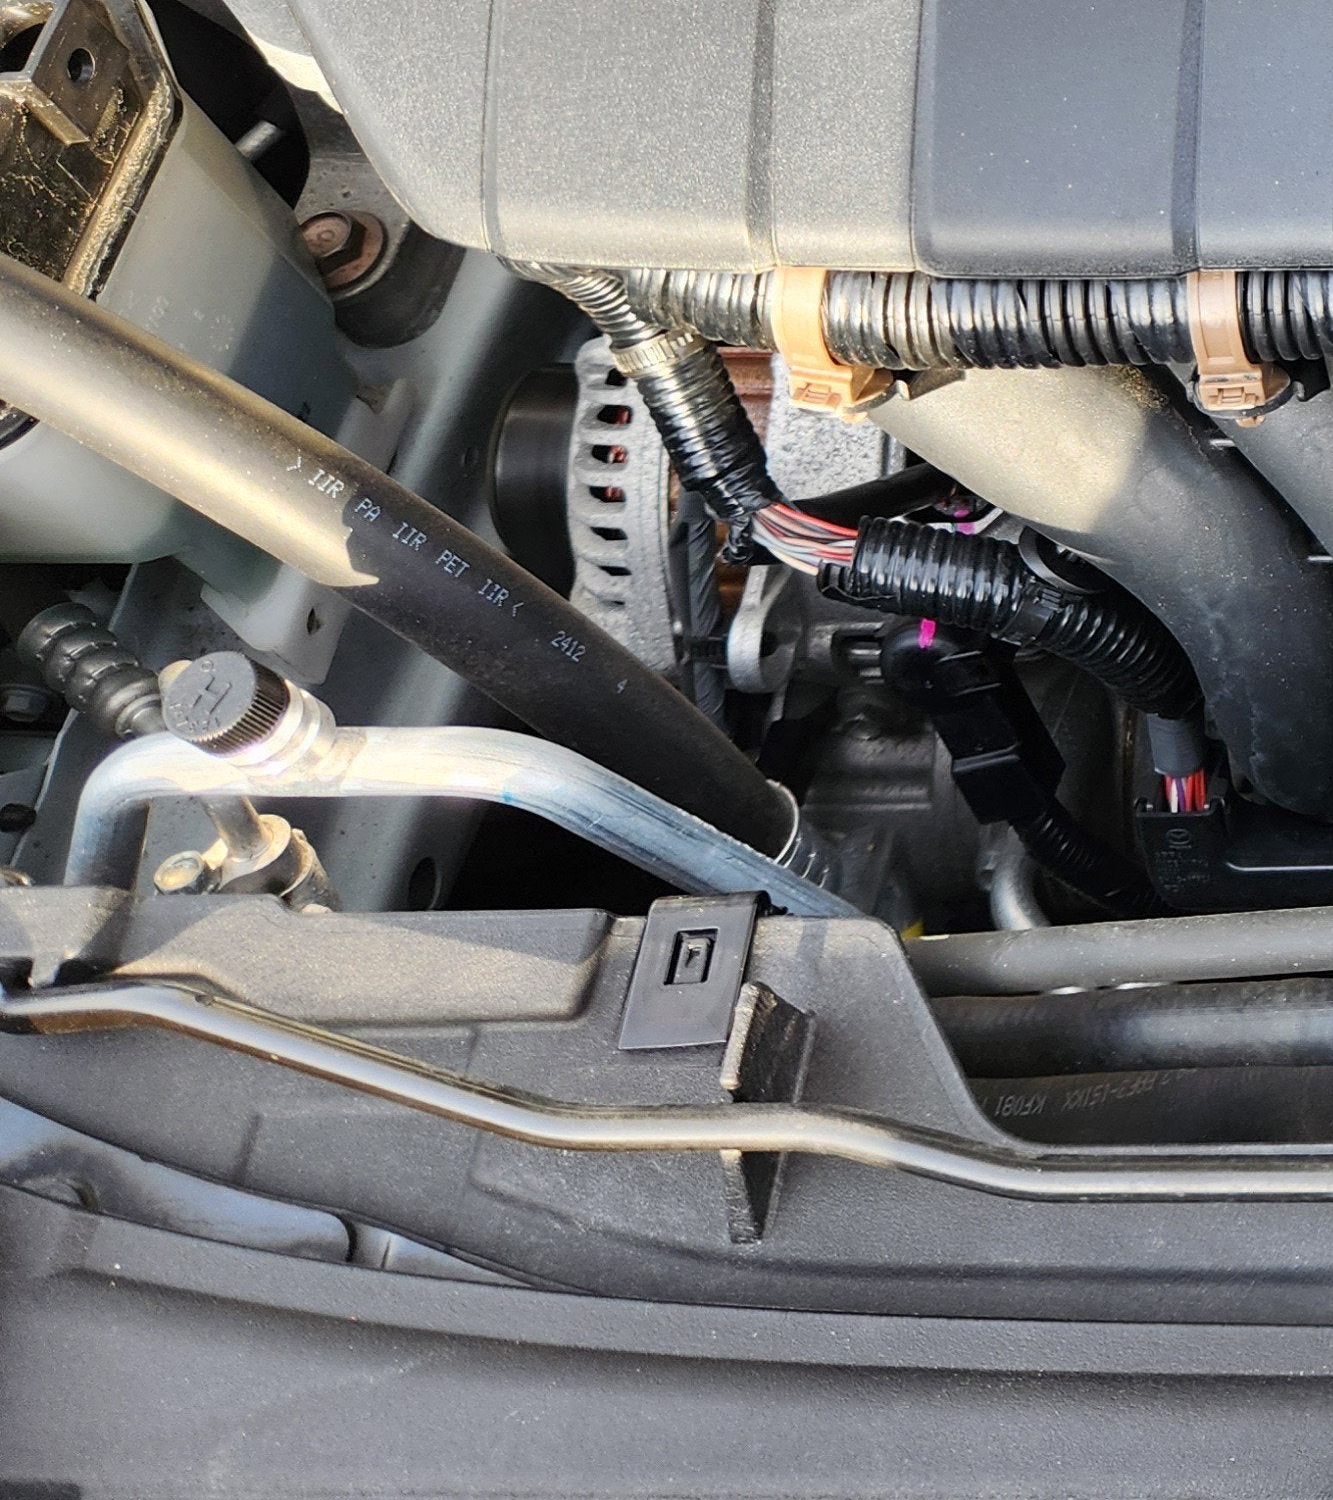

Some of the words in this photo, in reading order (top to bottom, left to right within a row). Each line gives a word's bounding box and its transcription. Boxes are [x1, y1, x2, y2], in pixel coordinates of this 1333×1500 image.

[354, 497, 381, 522] PA
[435, 549, 470, 578] PET
[550, 630, 586, 662] 2412
[616, 678, 628, 694] 4
